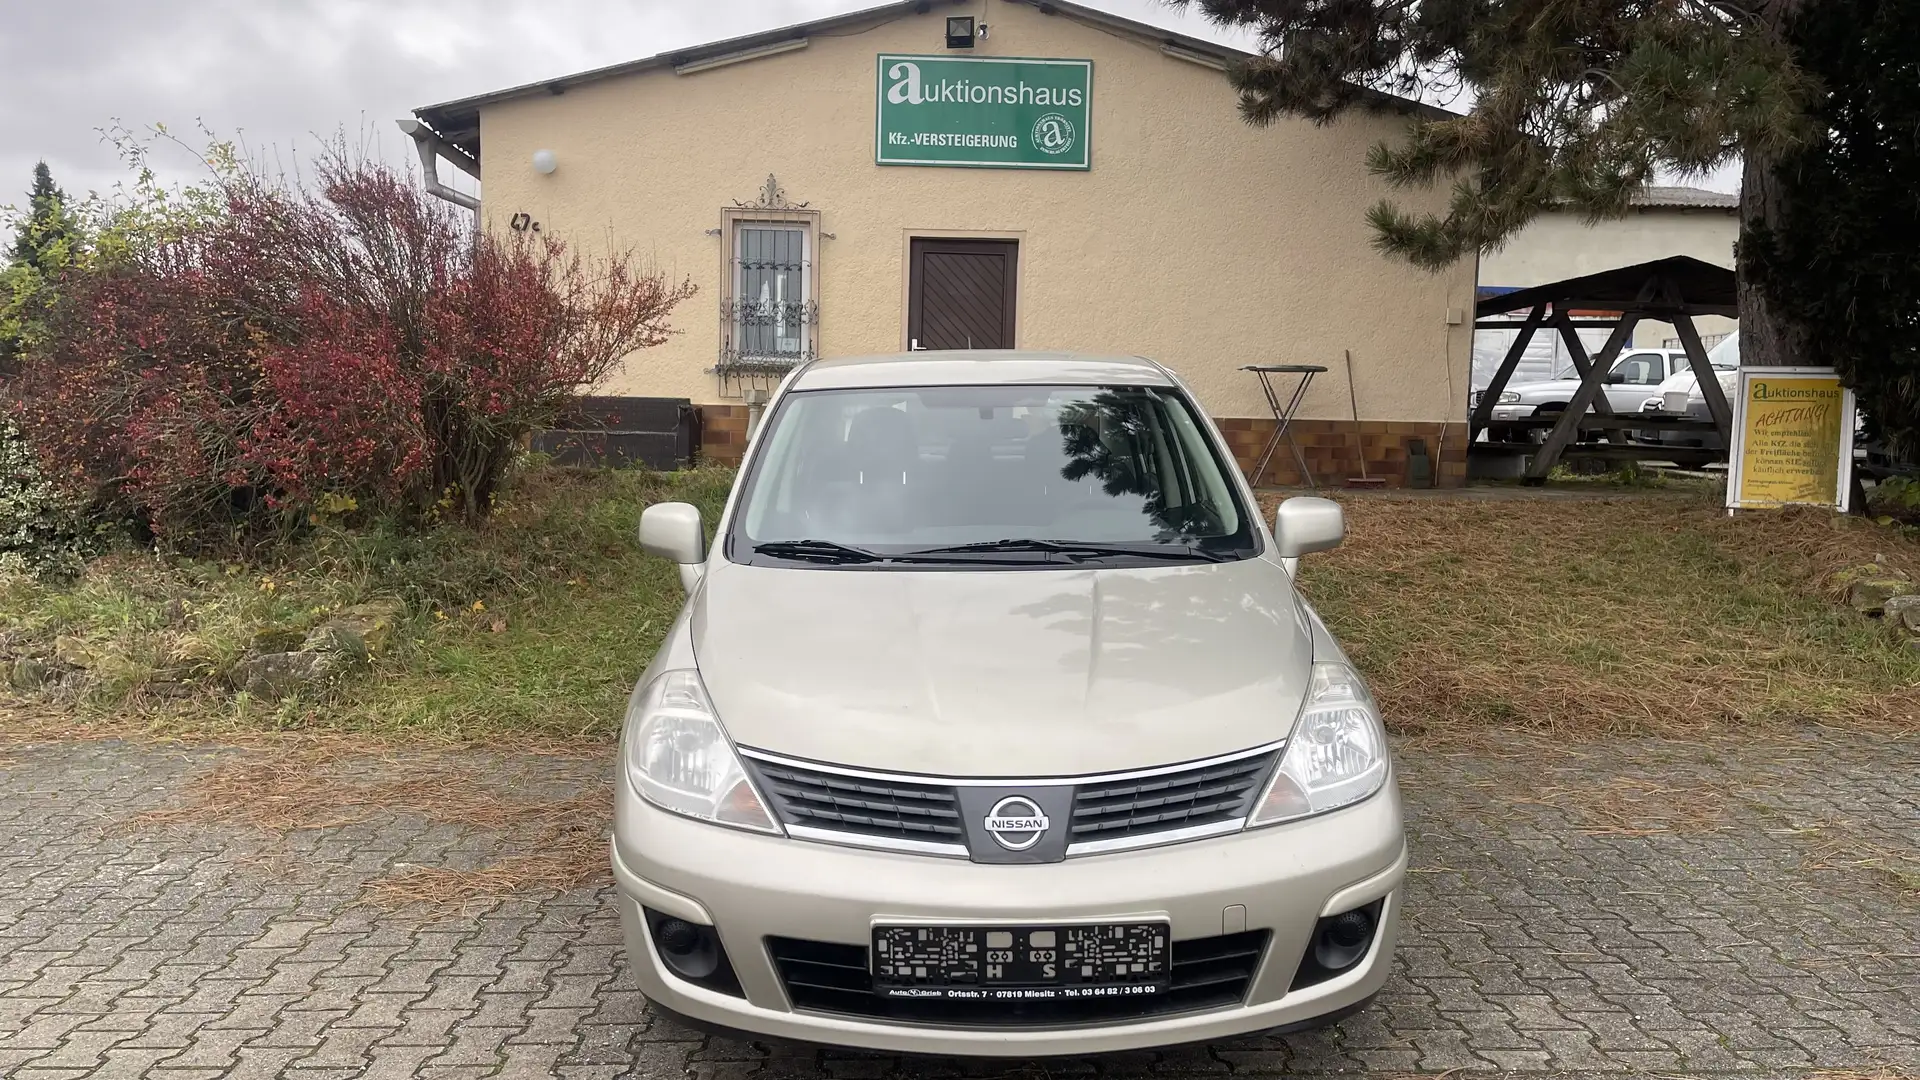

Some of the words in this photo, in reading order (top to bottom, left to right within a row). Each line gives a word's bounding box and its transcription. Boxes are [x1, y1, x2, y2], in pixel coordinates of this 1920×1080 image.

[888, 62, 1082, 106] auktionshaus
[888, 132, 1018, 148] Kfz.-VERSTEIGERUNG
[1753, 382, 1840, 400] auktionshaus
[1756, 404, 1830, 427] ACHTUNG!
[991, 819, 1043, 829] NISSAN
[986, 964, 1003, 979] H
[1042, 963, 1057, 979] S
[948, 990, 980, 998] Ortsstr.
[981, 990, 988, 998] 7
[996, 990, 1022, 998] 07819
[1024, 989, 1055, 998] Miesitz
[1065, 989, 1080, 997] Tel.
[1081, 988, 1093, 996] 03
